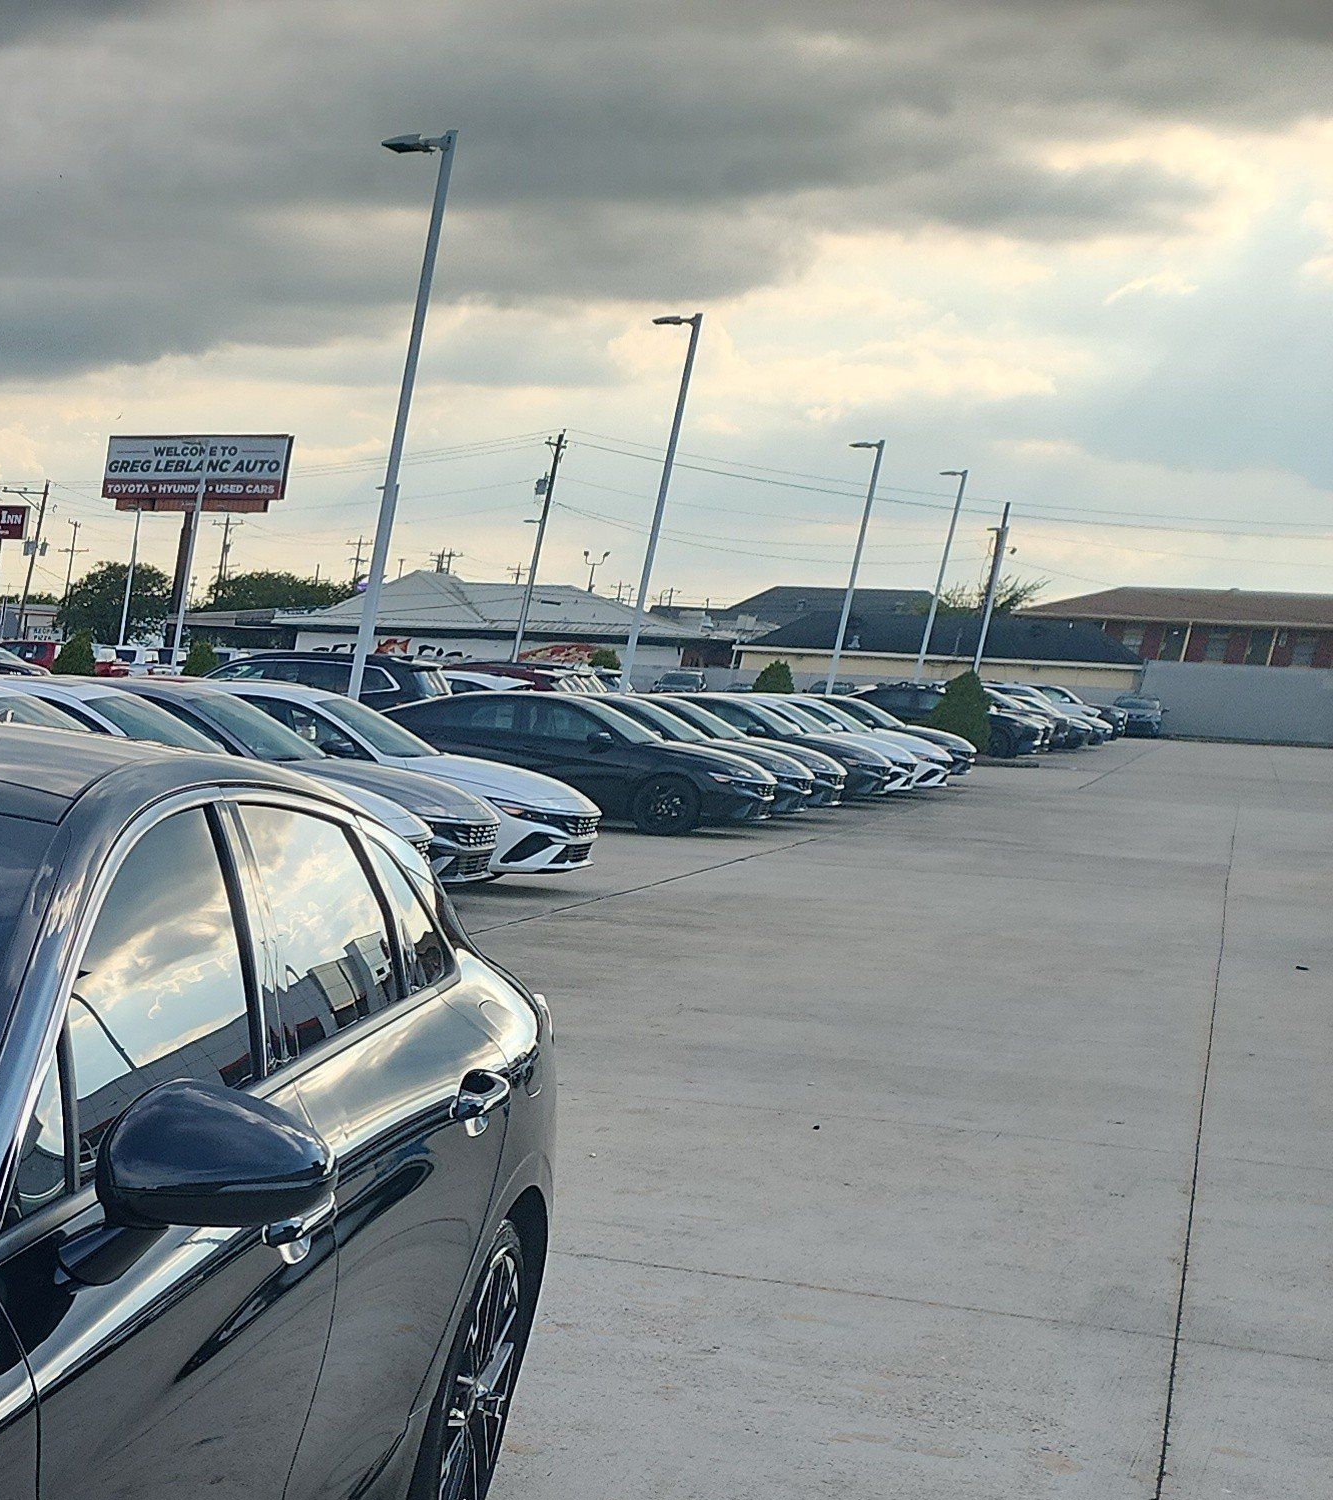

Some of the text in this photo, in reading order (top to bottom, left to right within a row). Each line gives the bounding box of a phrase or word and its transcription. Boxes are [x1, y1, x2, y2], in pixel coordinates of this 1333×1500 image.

[220, 446, 238, 457] TO
[108, 459, 281, 473] GREG LEBLANC AUTO
[107, 484, 150, 494] TOYOTA
[215, 484, 242, 494] USED
[245, 484, 275, 494] CARS
[0, 510, 23, 525] INN
